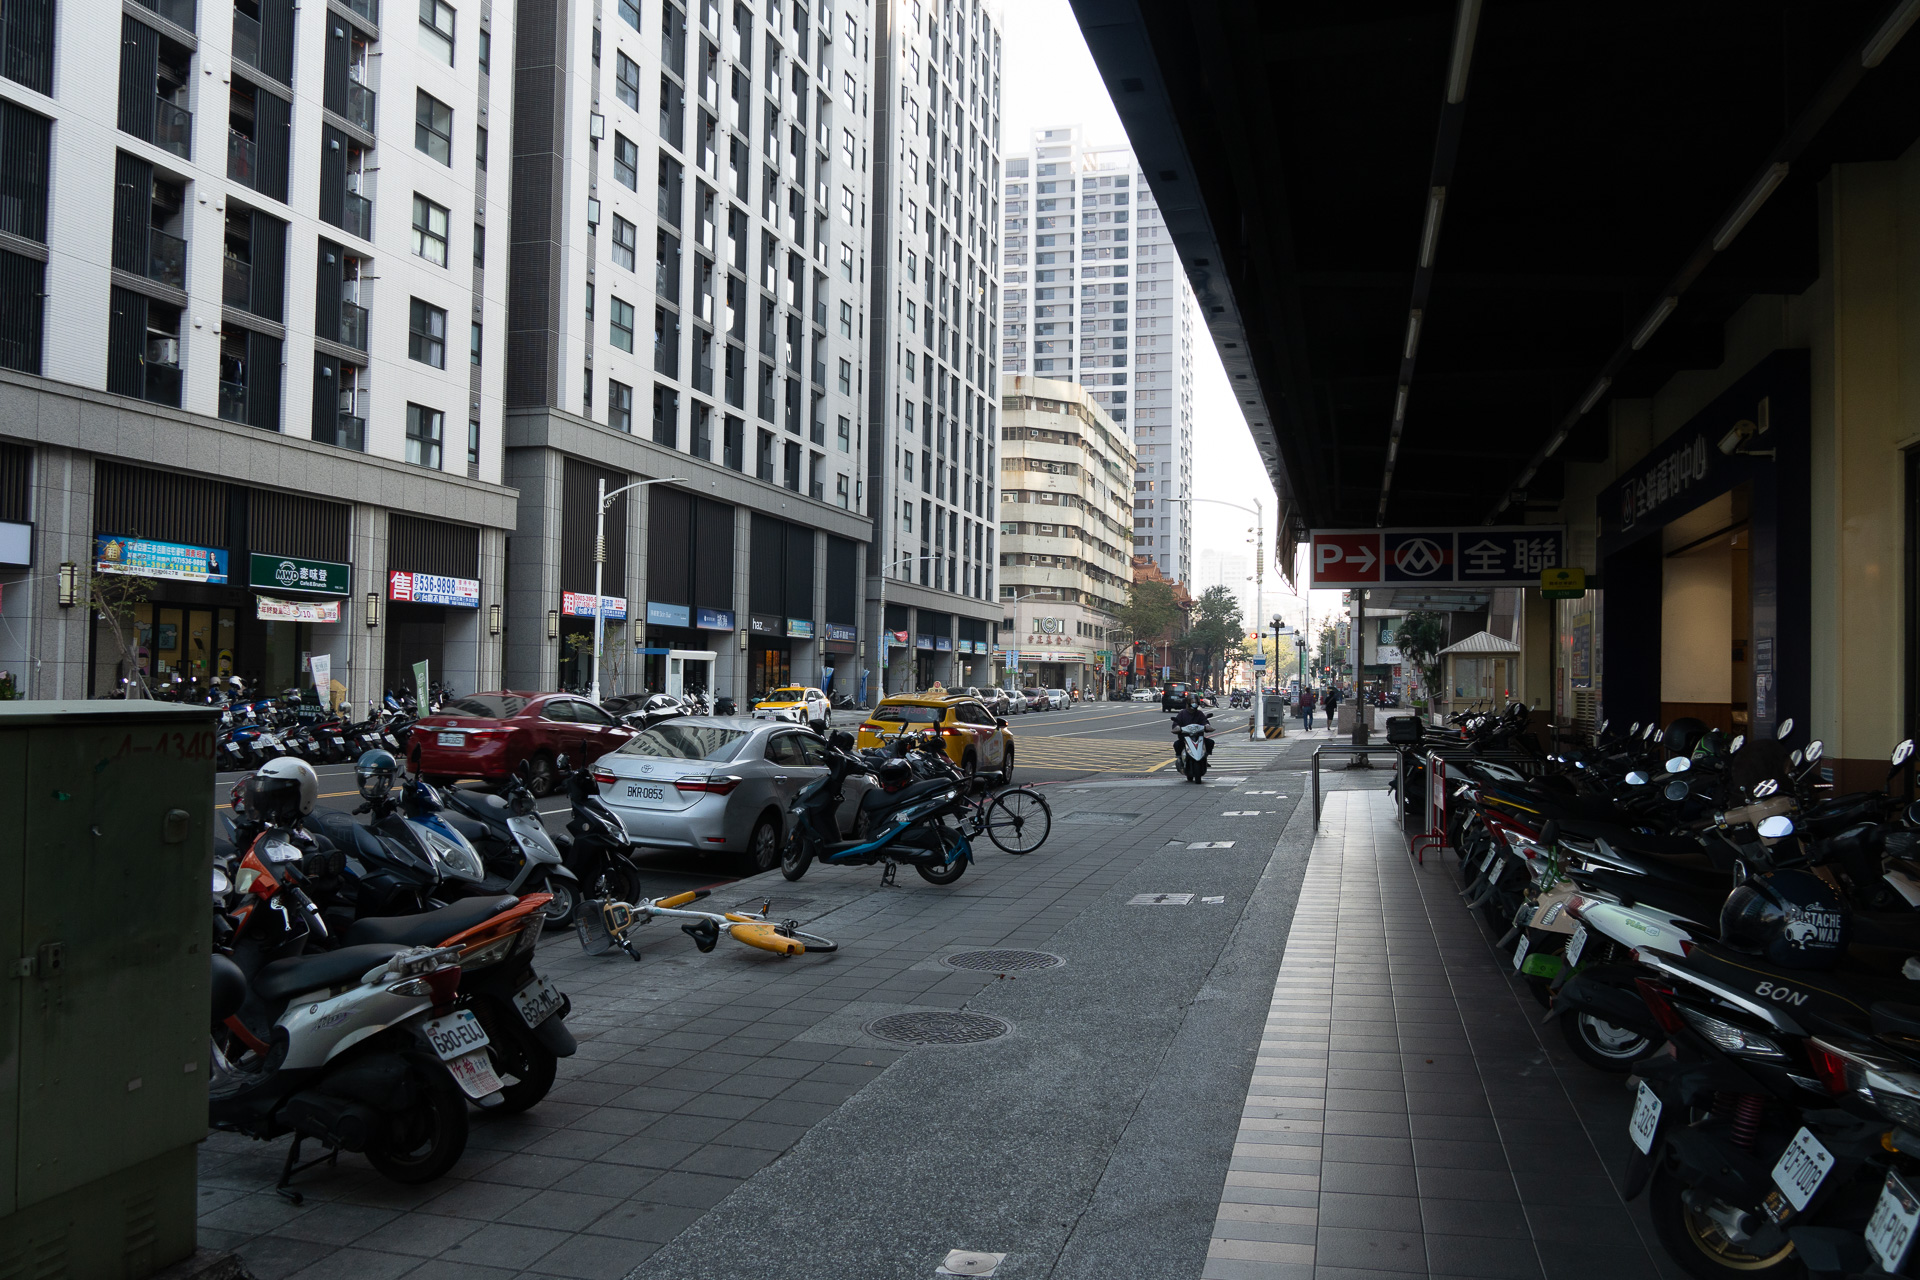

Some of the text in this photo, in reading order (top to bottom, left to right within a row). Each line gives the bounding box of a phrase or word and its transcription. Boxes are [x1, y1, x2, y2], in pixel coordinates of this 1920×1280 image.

[1316, 544, 1343, 573] P
[1464, 538, 1556, 574] 全聯
[276, 568, 299, 582] MWD
[391, 572, 412, 600] 售
[420, 575, 456, 594] 536-9898
[564, 593, 574, 613] 租
[752, 617, 763, 631] haz
[1381, 629, 1394, 644] 85
[627, 785, 664, 800] BKR-0853
[1818, 927, 1841, 943] WAX
[522, 984, 561, 1022] 652-MCJ
[1754, 981, 1809, 1006] BON
[432, 1020, 485, 1054] 680-EUJ
[1779, 1140, 1823, 1196] PCF-7008
